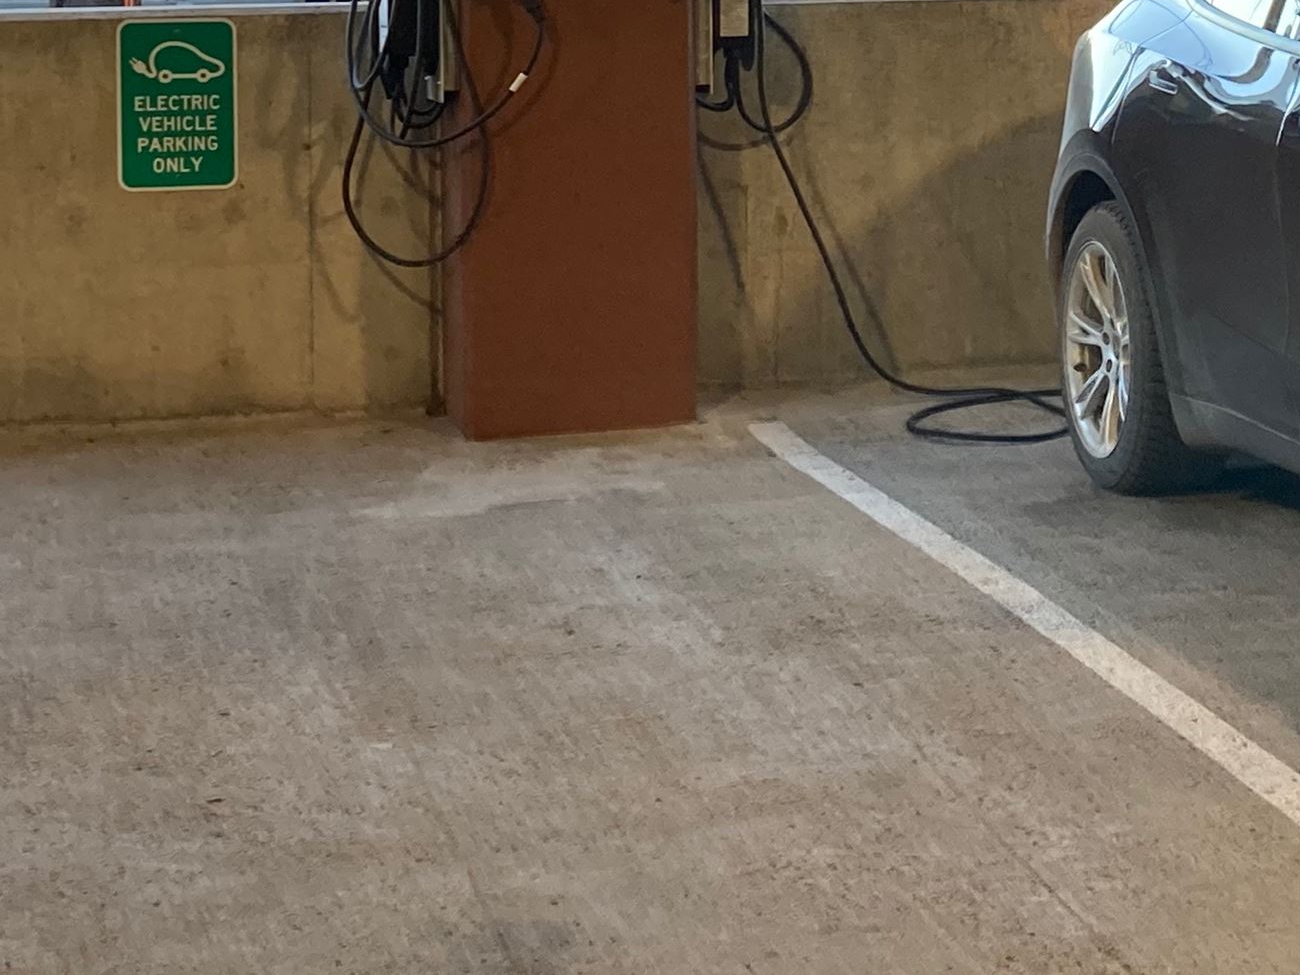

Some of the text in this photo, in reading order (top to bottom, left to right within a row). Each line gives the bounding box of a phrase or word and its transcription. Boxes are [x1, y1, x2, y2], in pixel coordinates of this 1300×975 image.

[134, 94, 220, 112] ELECTRIC
[139, 115, 217, 132] VEHICLE
[137, 136, 218, 153] PARKING
[153, 157, 203, 173] ONLY
